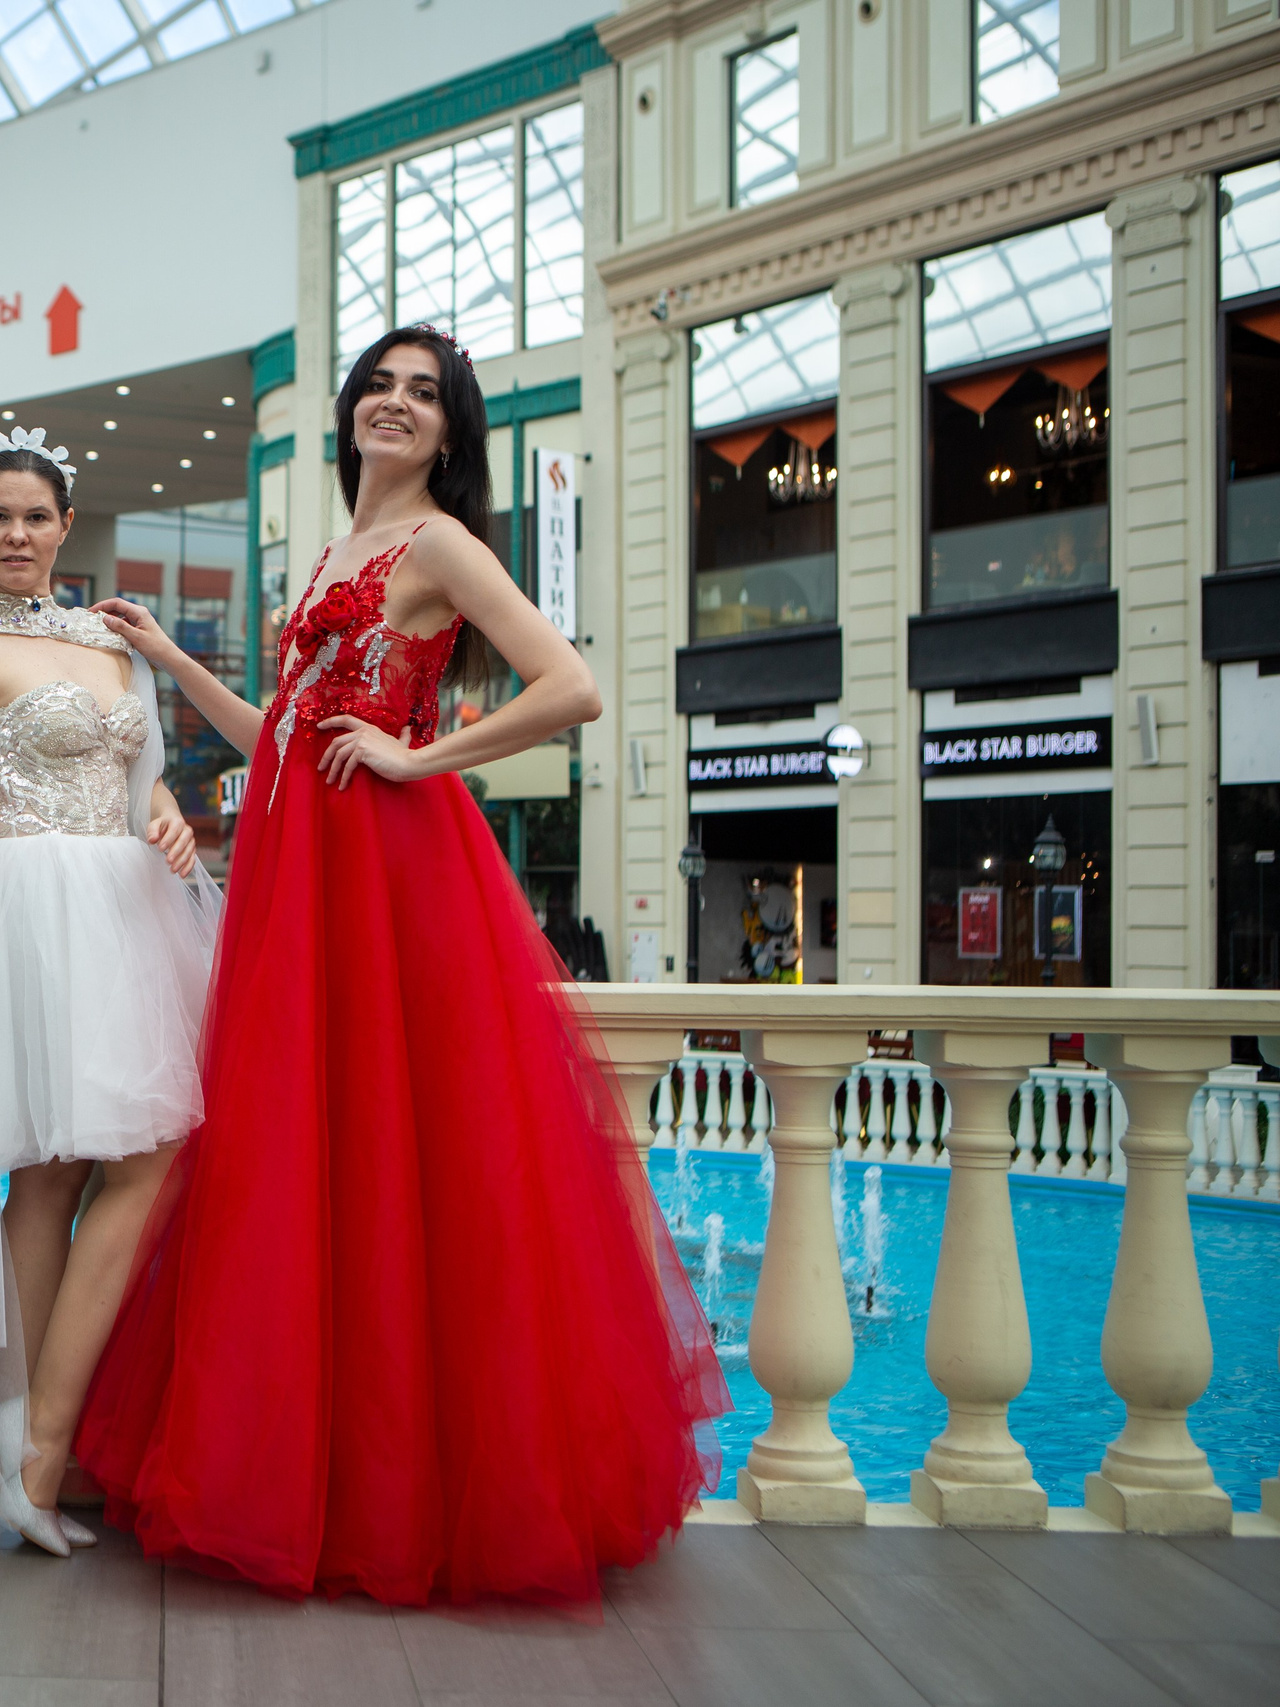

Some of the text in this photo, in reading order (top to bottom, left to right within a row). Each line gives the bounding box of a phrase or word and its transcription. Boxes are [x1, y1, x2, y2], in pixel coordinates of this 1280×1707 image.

[550, 516, 565, 631] ПАТИО
[923, 730, 1098, 765] BLACK STAR BURGER
[689, 757, 732, 781] BLACK
[734, 754, 769, 778] STAR
